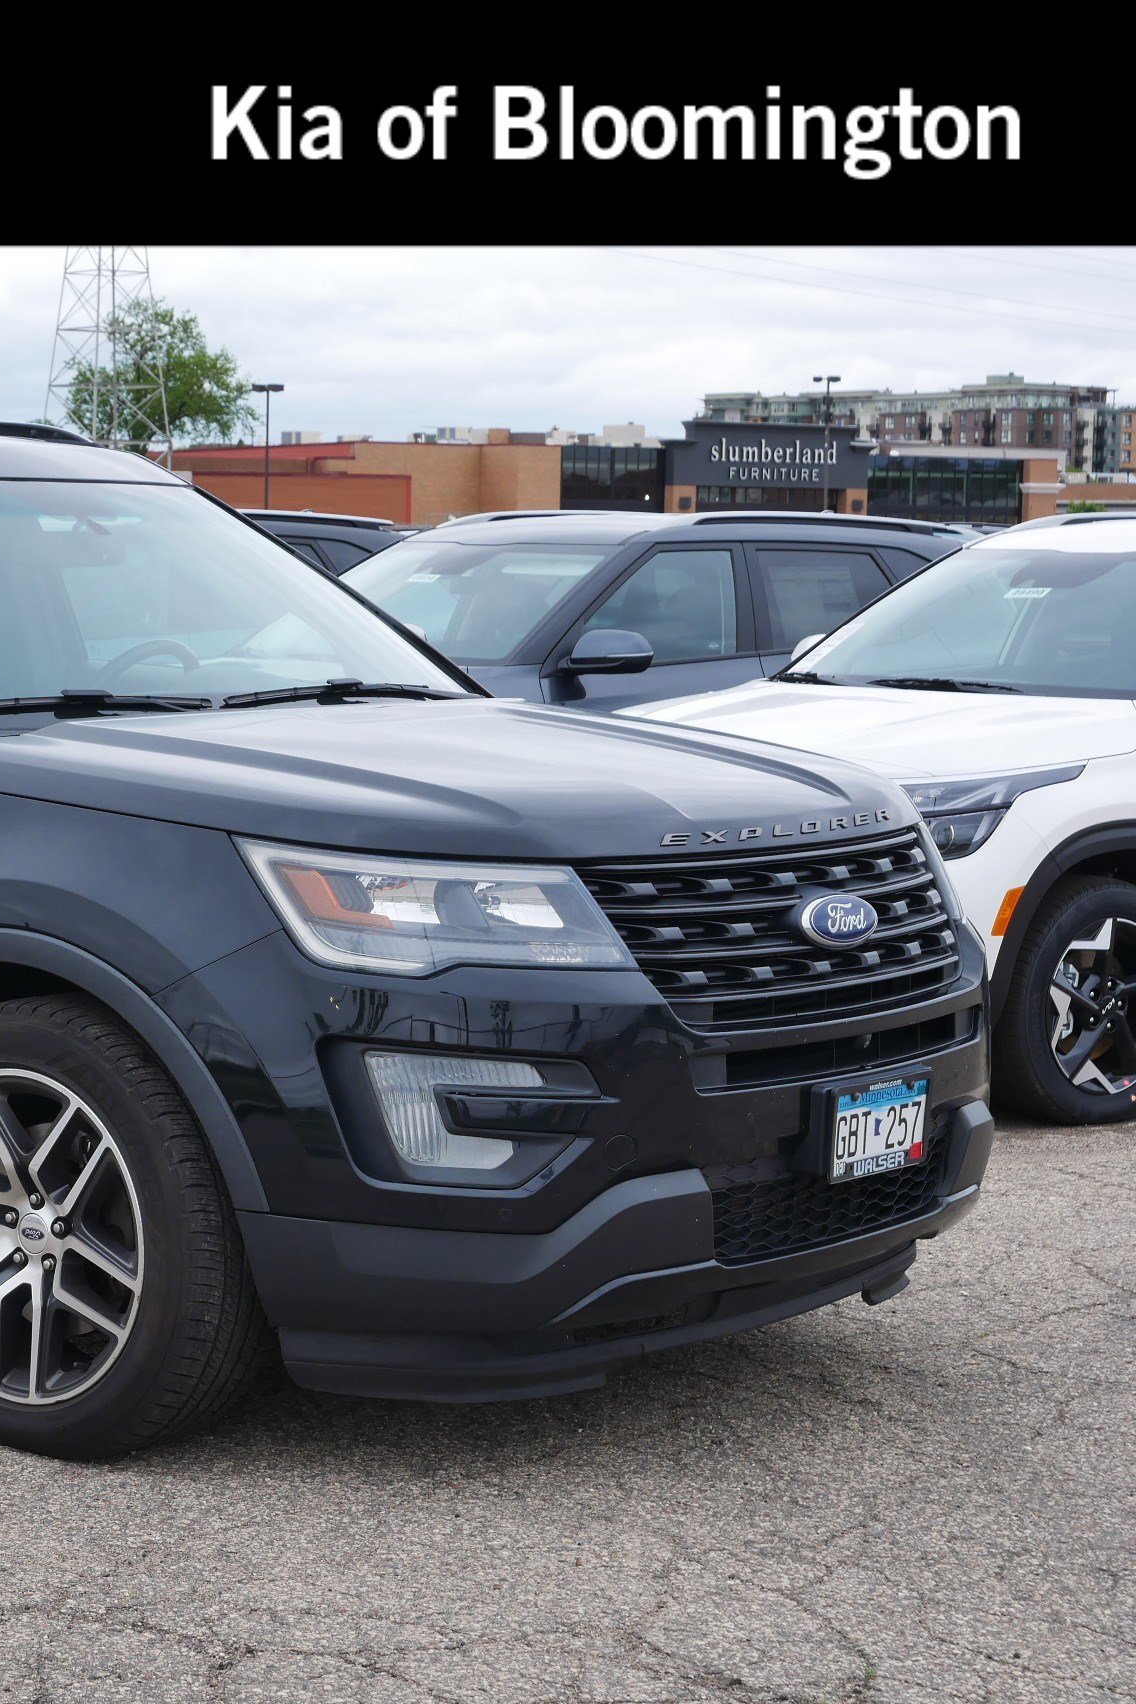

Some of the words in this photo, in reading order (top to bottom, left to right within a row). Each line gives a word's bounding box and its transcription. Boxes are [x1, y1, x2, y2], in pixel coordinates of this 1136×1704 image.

[710, 437, 837, 465] slumberland
[729, 466, 820, 482] FURNITURE
[660, 808, 892, 847] EXPLORER
[827, 902, 867, 934] Ford
[835, 1110, 872, 1161] GBT
[884, 1100, 922, 1150] 257
[853, 1151, 905, 1177] WALSER
